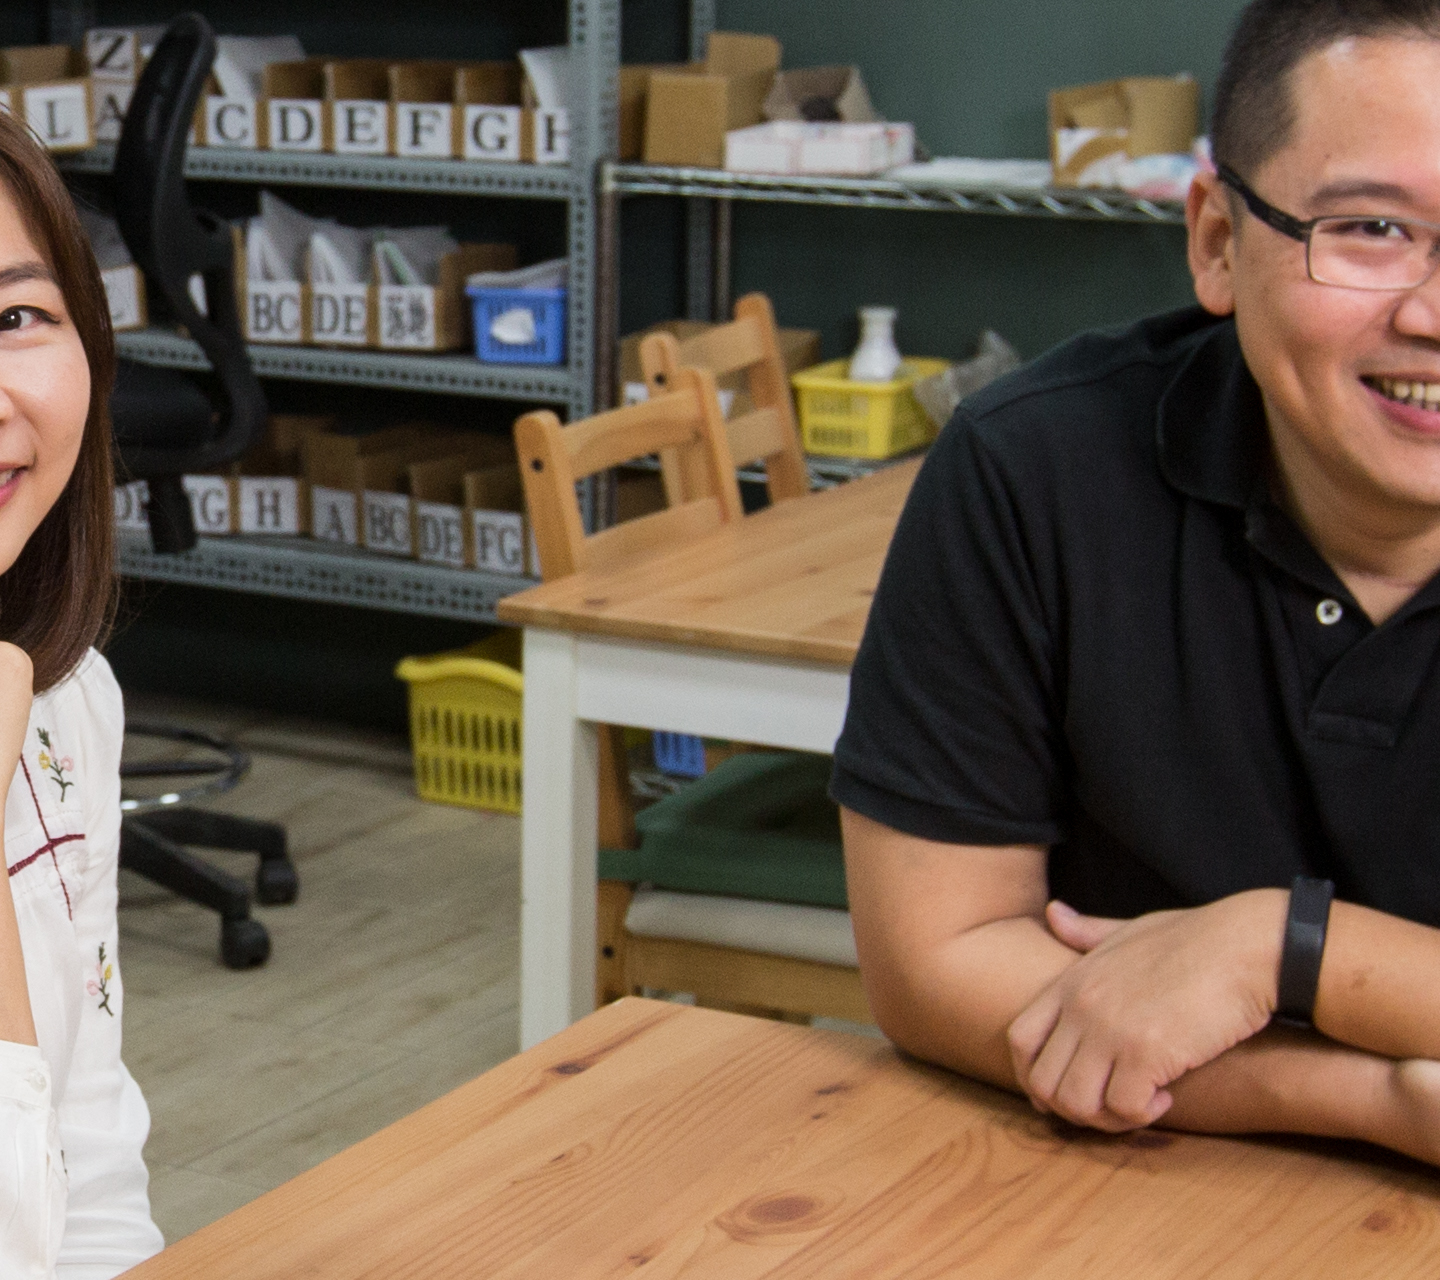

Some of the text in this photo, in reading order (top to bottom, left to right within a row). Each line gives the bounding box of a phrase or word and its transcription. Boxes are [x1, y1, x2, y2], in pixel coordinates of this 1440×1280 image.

[91, 32, 129, 72] Z
[46, 99, 72, 139] L
[216, 103, 250, 141] C
[277, 106, 314, 144] D
[342, 107, 380, 145] E
[408, 109, 441, 147] F
[472, 111, 508, 151] G
[253, 293, 300, 334] BC
[313, 293, 366, 334] DE
[255, 489, 282, 528] H
[323, 503, 522, 566] A BC DE FG
